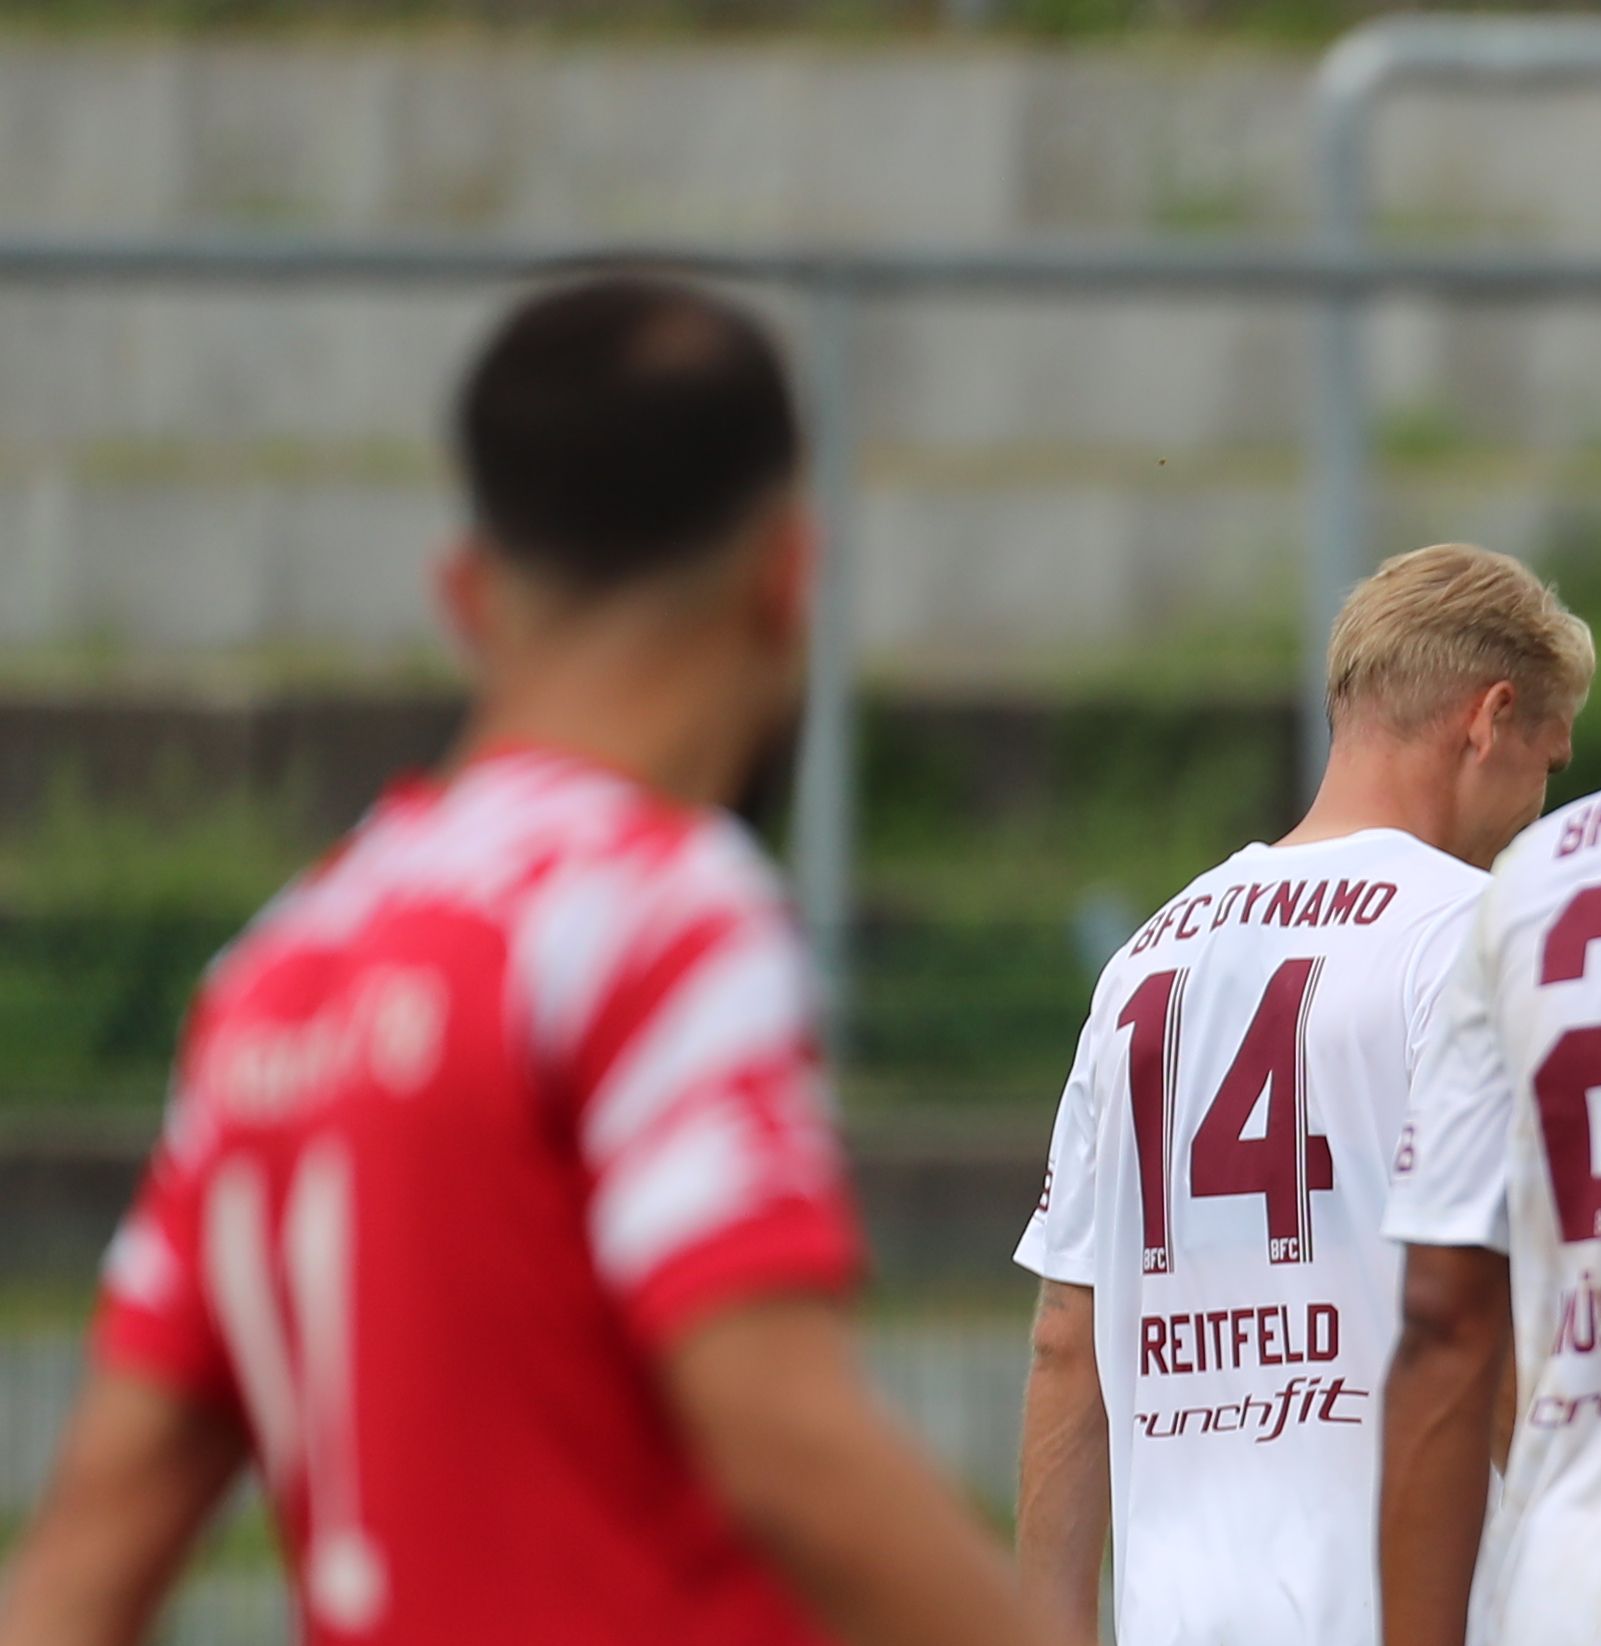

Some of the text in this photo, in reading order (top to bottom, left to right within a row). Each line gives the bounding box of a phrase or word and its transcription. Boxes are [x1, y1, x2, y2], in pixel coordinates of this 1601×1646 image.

[1128, 878, 1398, 958] BFC DYNAMO
[1116, 955, 1334, 1276] 14
[1143, 1248, 1167, 1270] BFC
[1270, 1237, 1298, 1261] BFC
[1139, 1302, 1340, 1377] REITFELD
